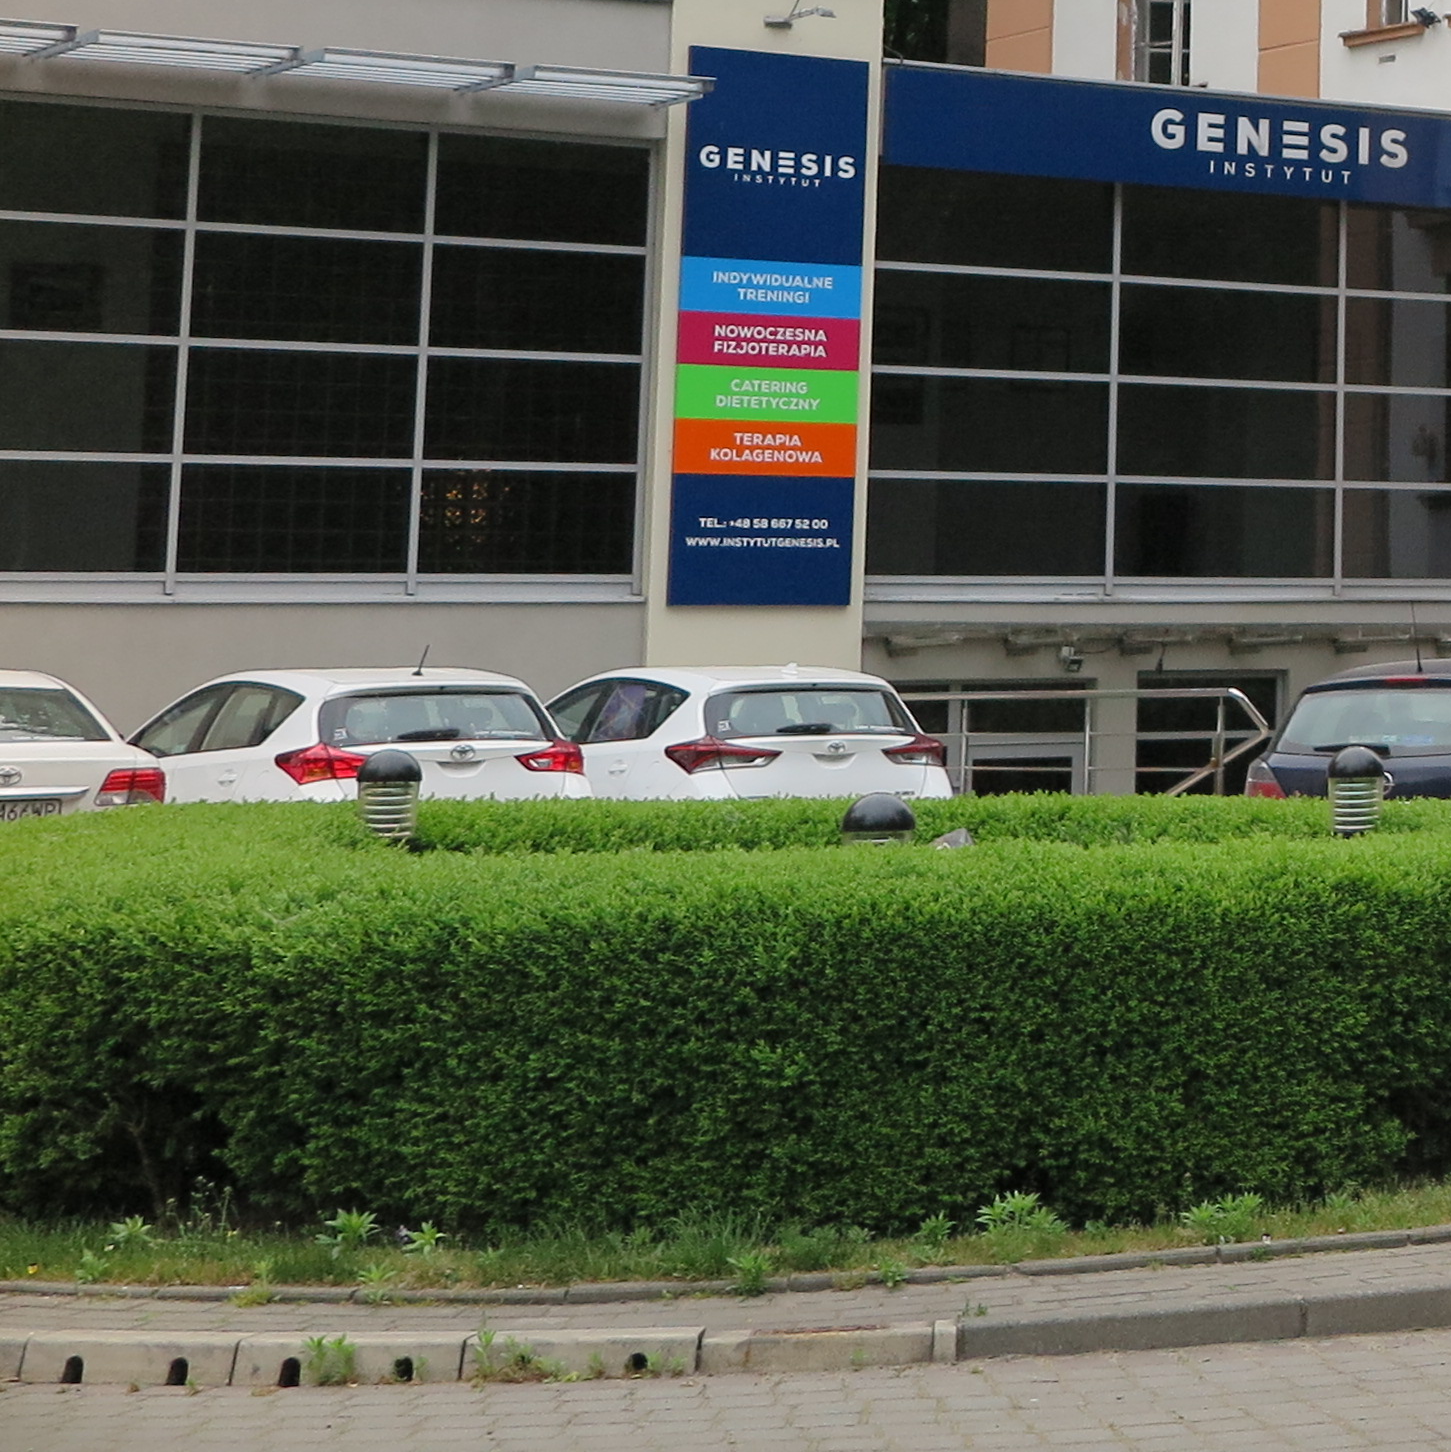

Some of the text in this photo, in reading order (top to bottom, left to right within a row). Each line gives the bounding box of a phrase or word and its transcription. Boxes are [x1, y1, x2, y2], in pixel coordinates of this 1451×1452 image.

[1150, 107, 1409, 169] GENESIS
[699, 144, 857, 179] GENESIS
[1209, 159, 1351, 185] INSTYTUT
[733, 173, 820, 187] INSTYTUT
[712, 271, 833, 289] INDYWIDUALNE
[738, 288, 809, 303] TRENINGI
[714, 324, 827, 341] NOWOCZESNA
[713, 341, 826, 357] FIZJOTERAPIA
[730, 379, 808, 394] CATERING
[715, 395, 820, 410] DIETETYCZNY
[734, 432, 801, 446] TERAPIA
[710, 448, 822, 463] KOLAGENOWA
[794, 519, 811, 529] 52
[811, 519, 829, 529] 00
[685, 537, 840, 548] WWW.INSTYTUTGENESIS.PL
